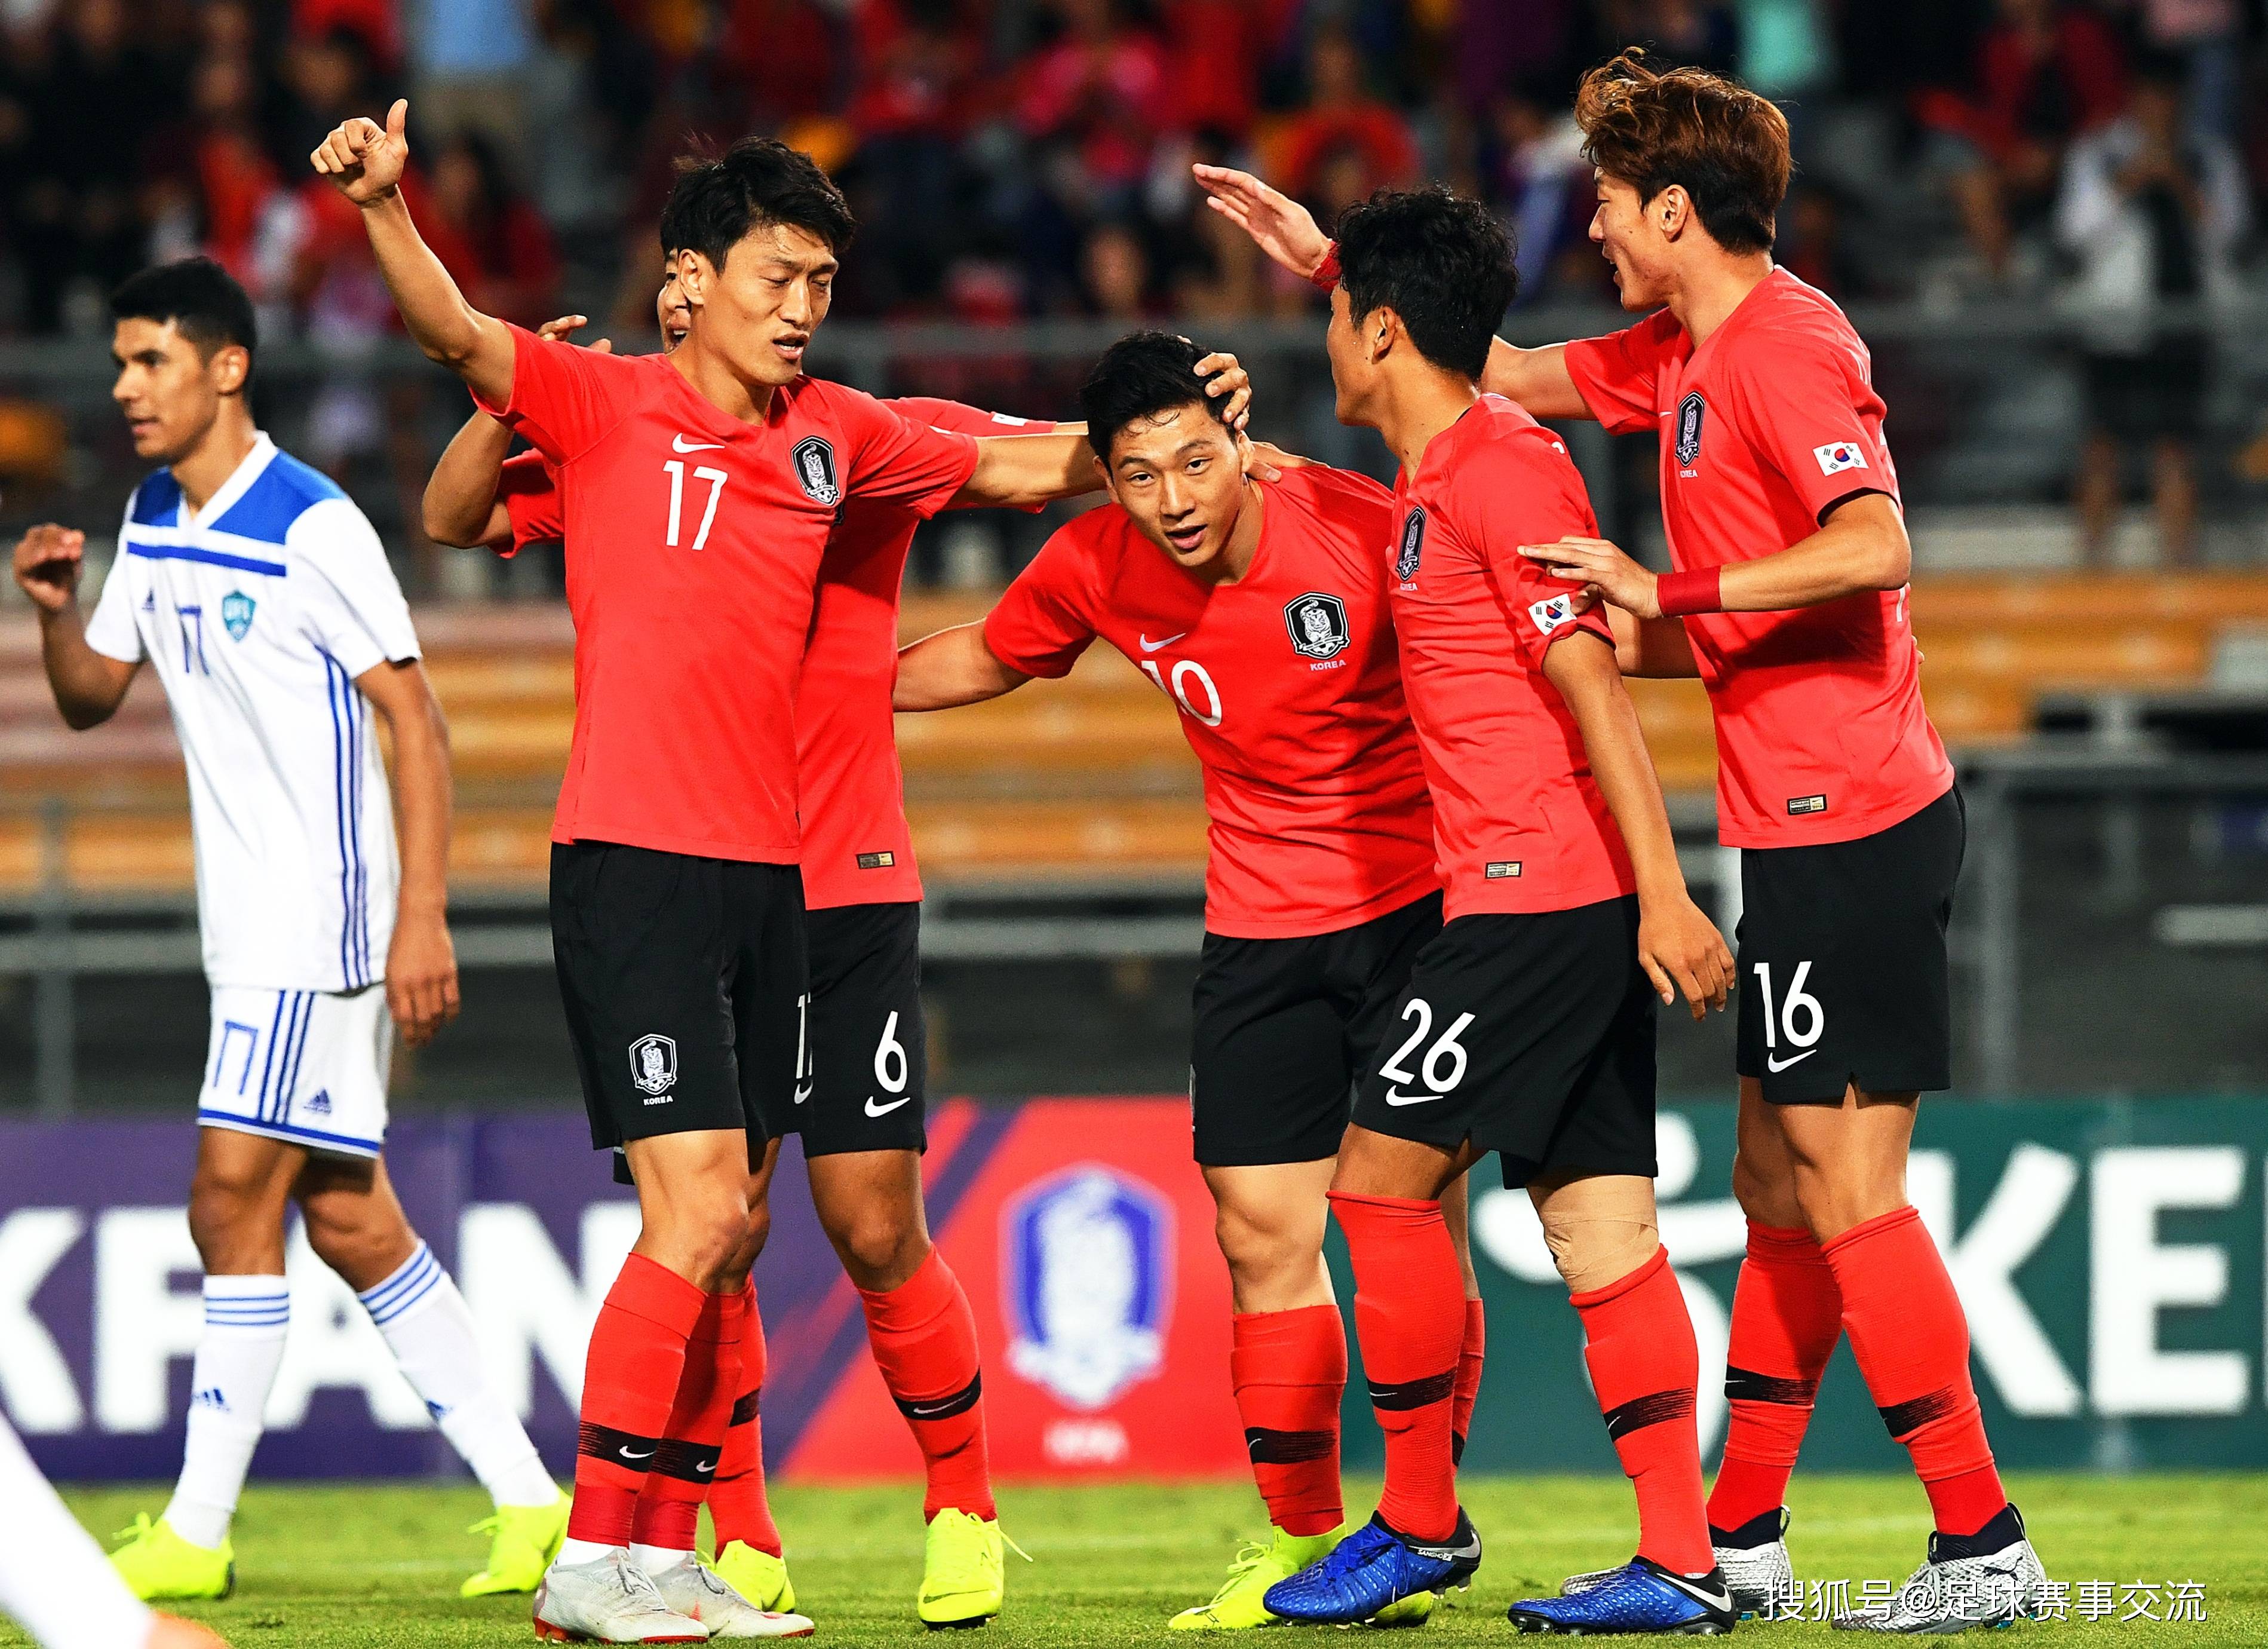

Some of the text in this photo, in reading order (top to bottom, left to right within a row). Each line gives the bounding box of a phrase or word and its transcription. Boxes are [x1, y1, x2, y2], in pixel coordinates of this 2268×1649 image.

[664, 461, 728, 550] 17
[175, 605, 209, 676] 17
[1310, 659, 1347, 671] KOREA
[1140, 660, 1222, 727] 10
[1754, 961, 1824, 1048] 16
[214, 1020, 259, 1095] 17
[874, 1010, 907, 1093] 6
[1379, 998, 1476, 1093] 26
[643, 1095, 674, 1106] KOREA
[1902, 1144, 2268, 1417] KE
[1417, 1549, 1443, 1559] SANGHO
